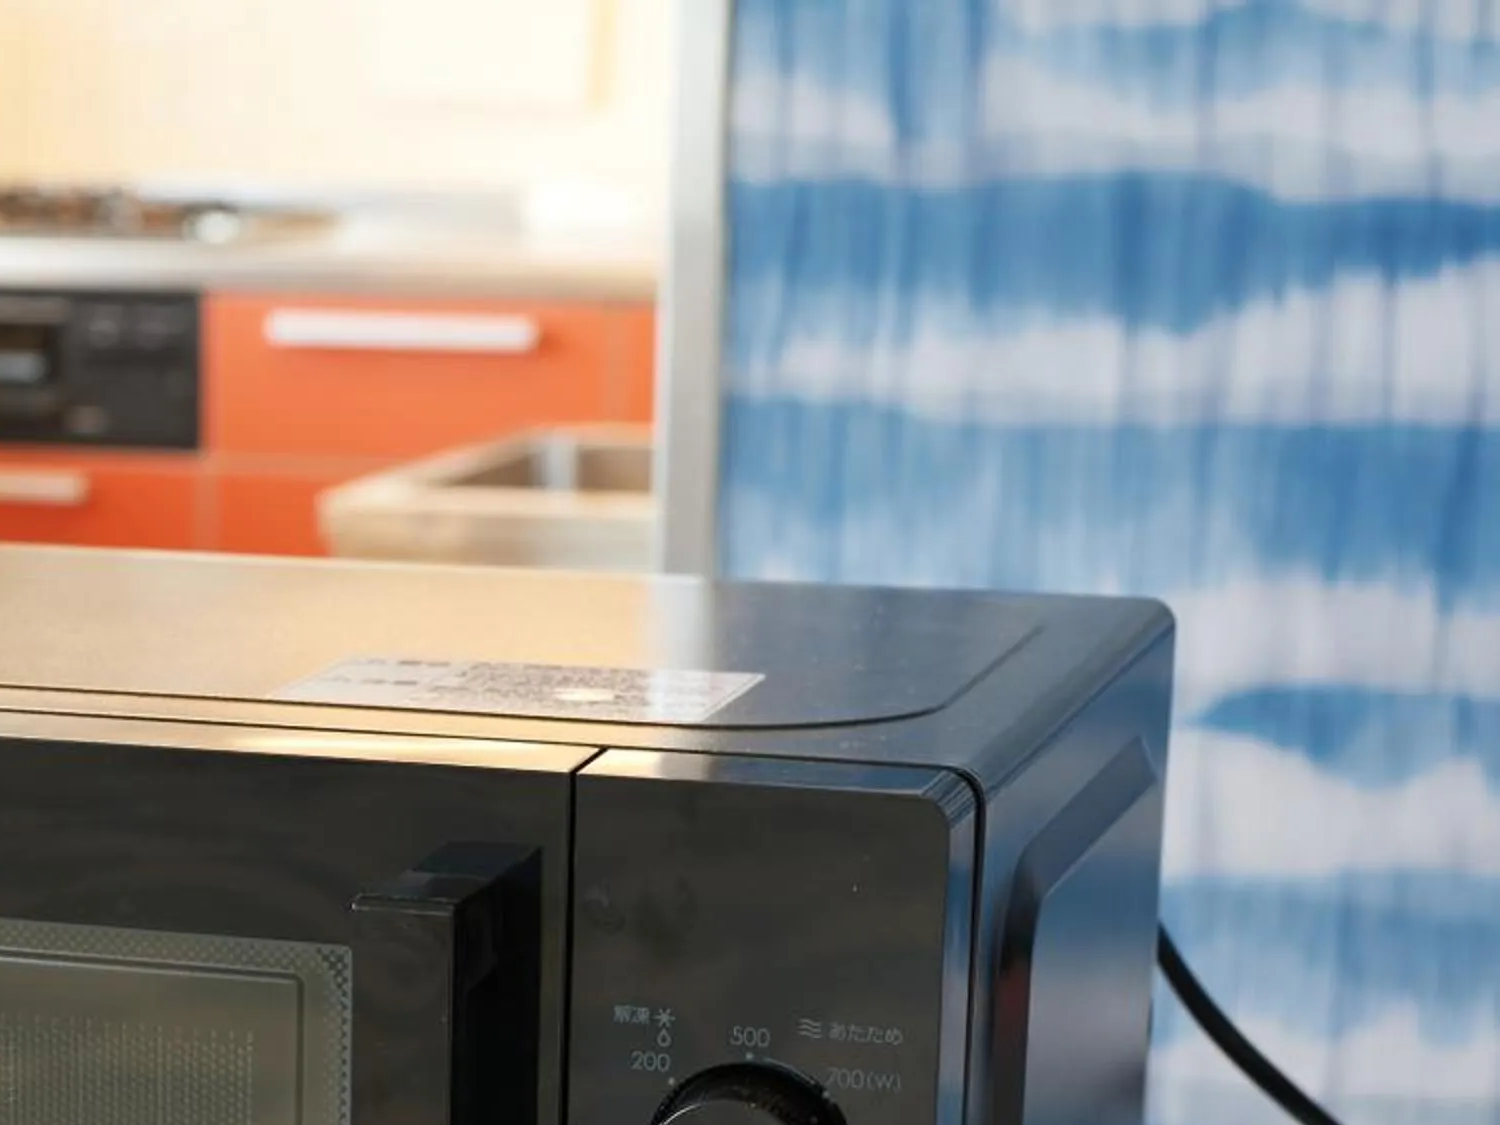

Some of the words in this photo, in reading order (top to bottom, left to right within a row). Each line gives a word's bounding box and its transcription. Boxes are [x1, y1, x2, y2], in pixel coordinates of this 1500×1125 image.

[729, 1027, 771, 1048] 500
[828, 1022, 904, 1046] あたため
[630, 1050, 671, 1074] 200
[826, 1067, 902, 1092] 700(W)
